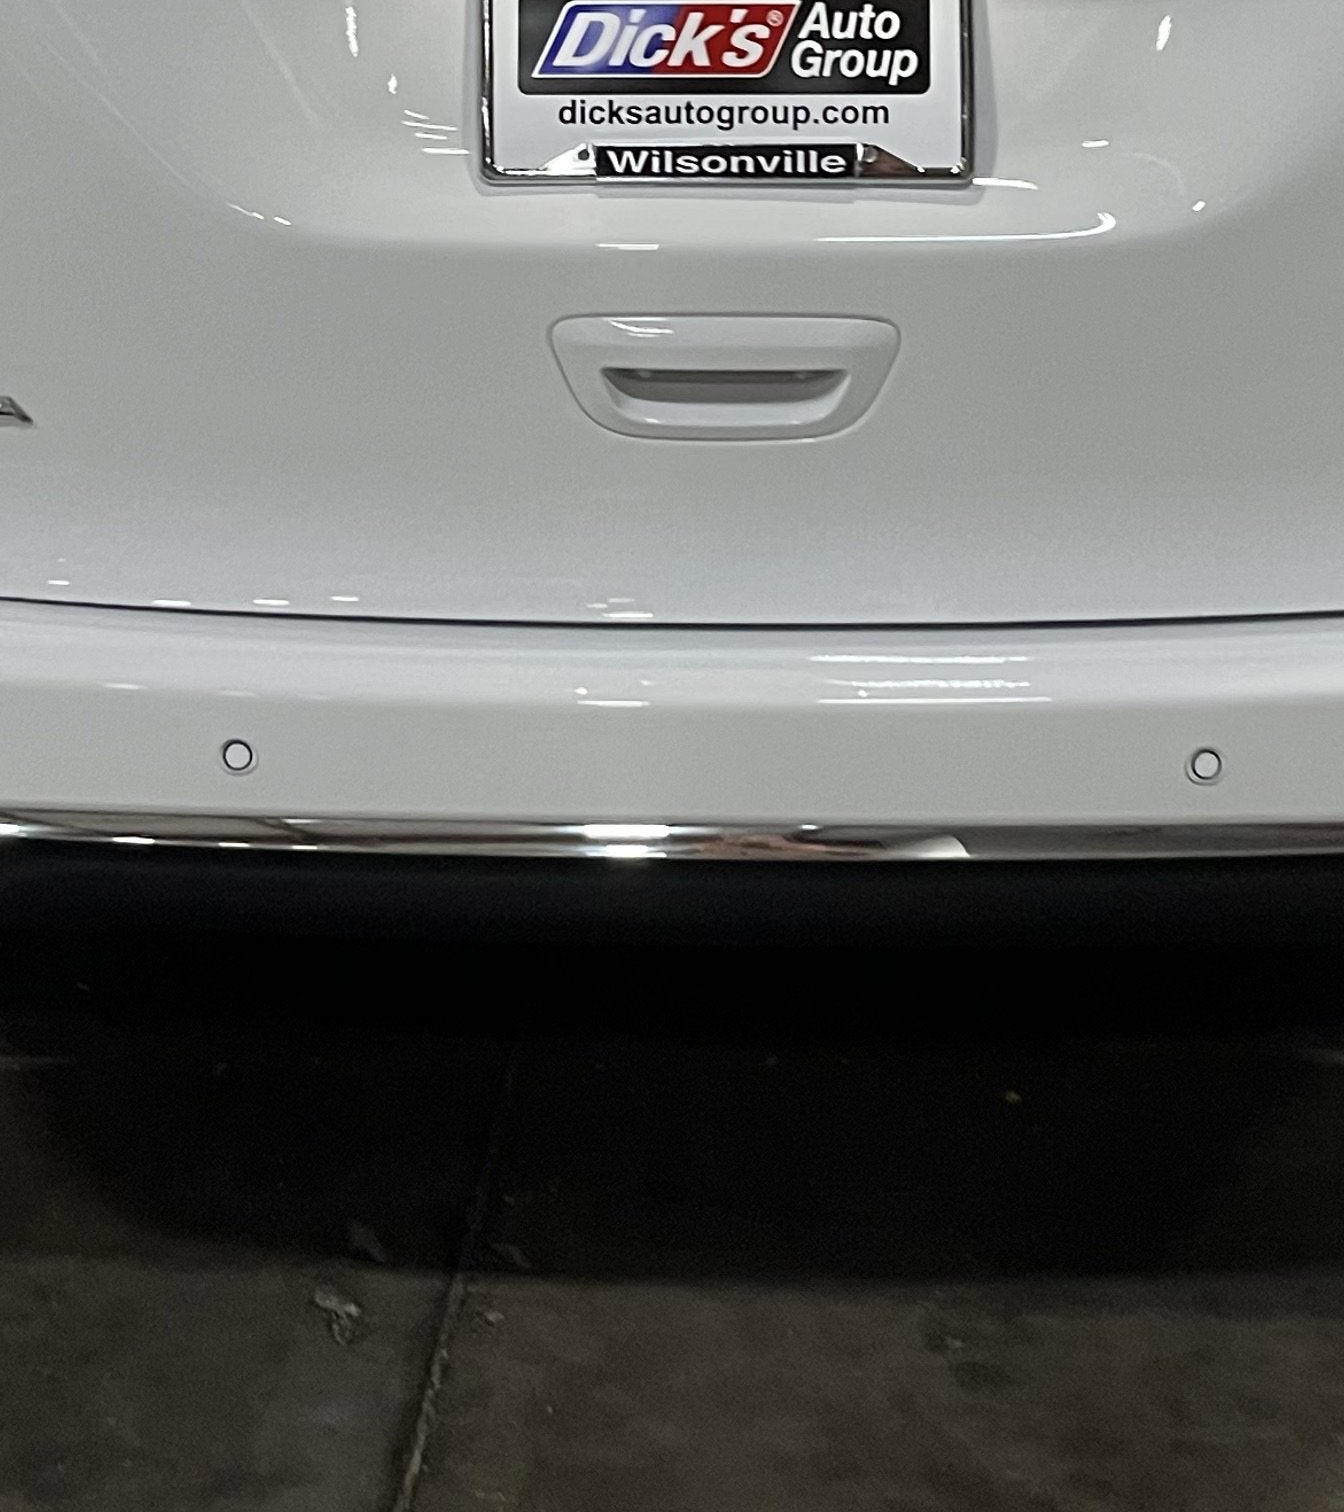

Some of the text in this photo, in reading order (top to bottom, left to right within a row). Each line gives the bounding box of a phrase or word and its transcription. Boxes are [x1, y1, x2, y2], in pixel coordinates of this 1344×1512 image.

[552, 8, 771, 69] Dick's
[798, 1, 901, 41] Auto
[790, 40, 919, 86] Group
[558, 100, 890, 130] dicksautogroup.com
[606, 149, 848, 174] Wilsonville
